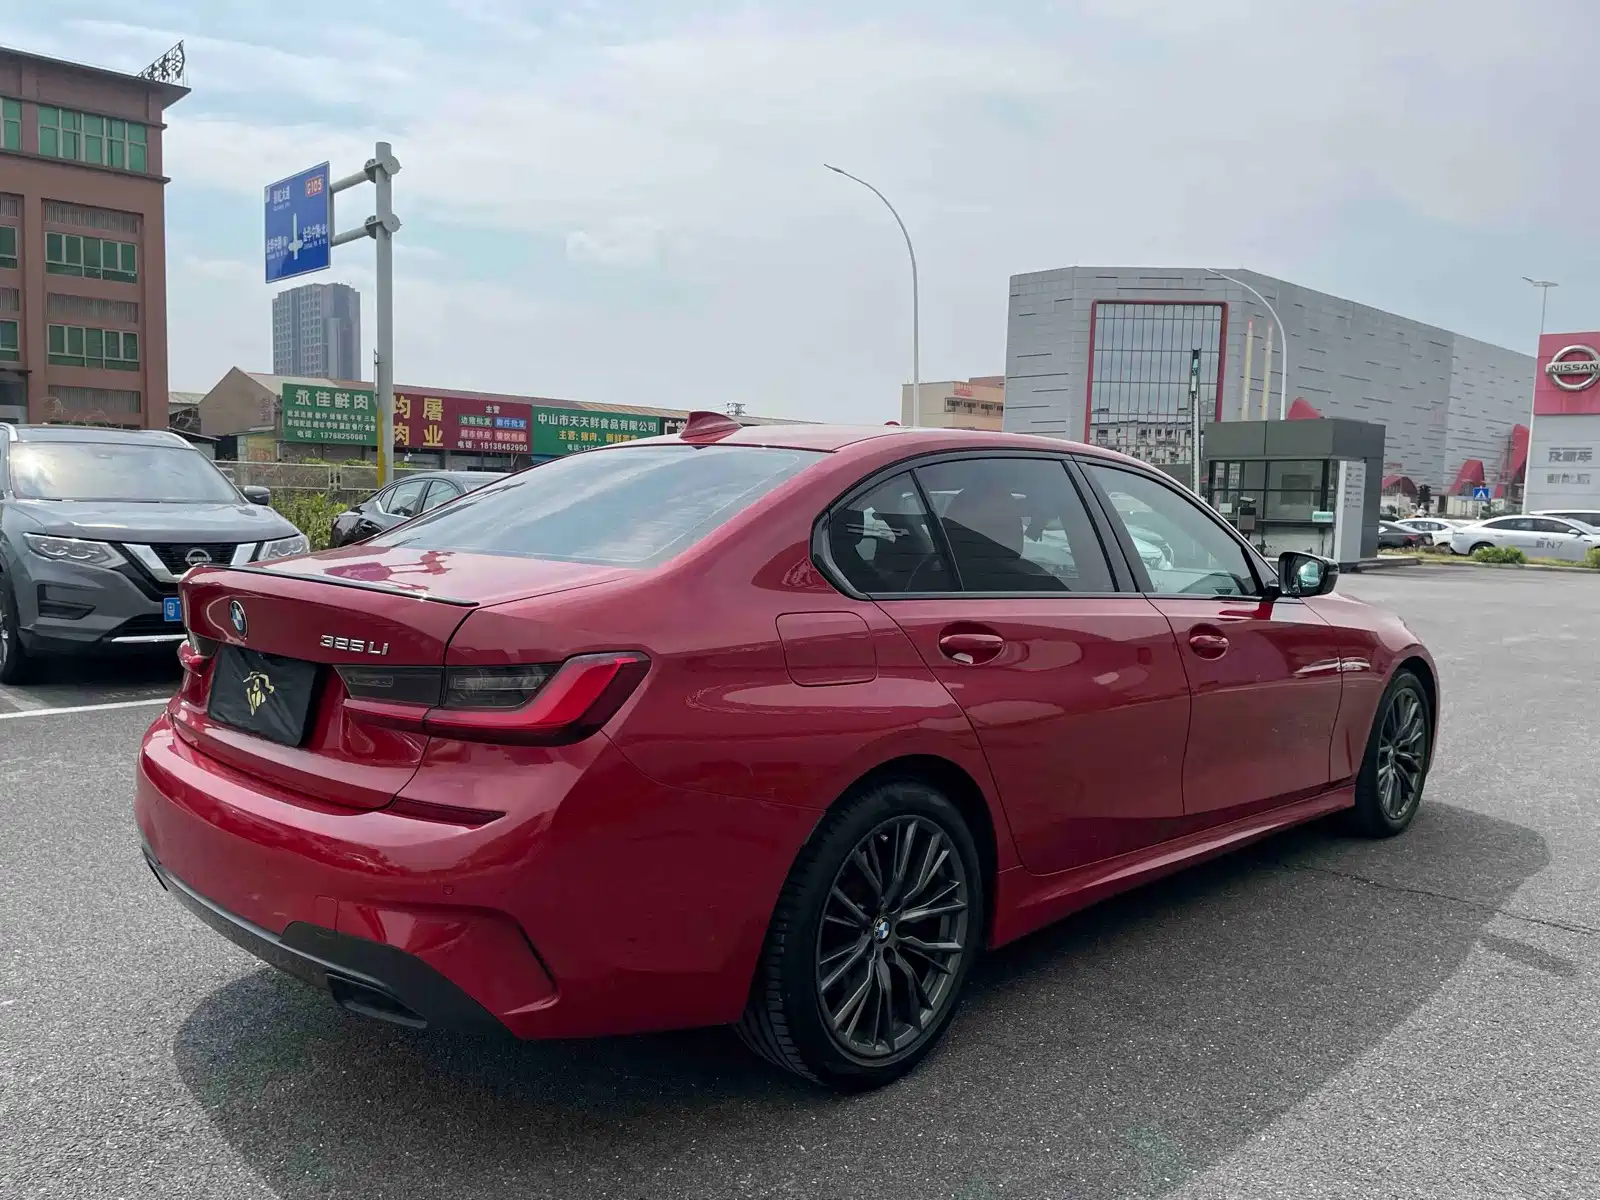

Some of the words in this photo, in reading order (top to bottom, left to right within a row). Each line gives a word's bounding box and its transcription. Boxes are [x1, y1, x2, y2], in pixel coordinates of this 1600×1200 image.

[1551, 363, 1600, 373] NISSAN
[295, 389, 369, 410] 永佳鲜肉
[485, 405, 500, 414] 主营
[537, 412, 657, 433] 中山市天天鲜食品有限公司
[480, 442, 528, 452] 18138452990
